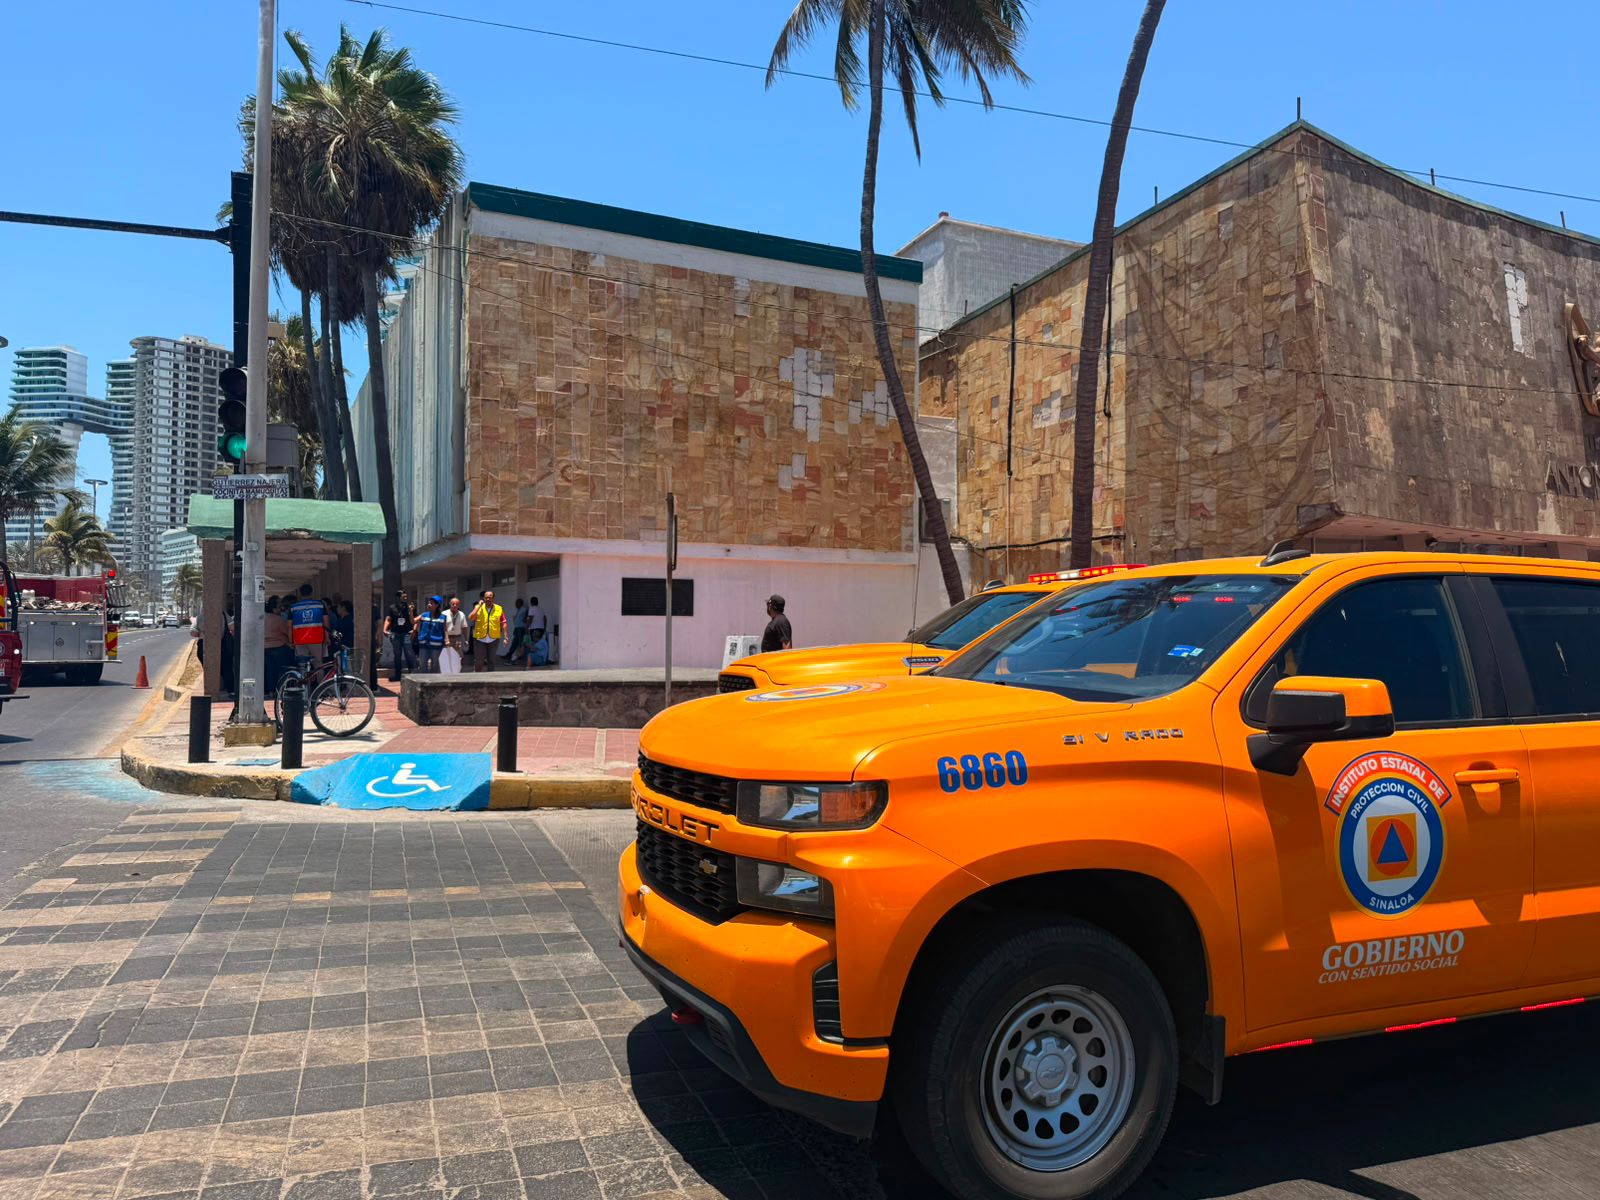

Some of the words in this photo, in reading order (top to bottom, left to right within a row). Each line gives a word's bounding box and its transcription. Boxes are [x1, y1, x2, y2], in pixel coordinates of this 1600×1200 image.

[937, 750, 1028, 793] 6860
[1331, 758, 1378, 807] INSTITUTO
[1380, 757, 1427, 784] ESTATAL
[1428, 779, 1445, 799] DE
[1350, 783, 1405, 819] PROTECCION
[1407, 789, 1429, 814] CIVIL
[1369, 893, 1415, 910] SINALOA
[1322, 930, 1465, 971] GOBIERNO
[1318, 970, 1350, 984] CON
[1351, 962, 1411, 980] SENTIDO
[1413, 956, 1459, 971] SOCIAL
